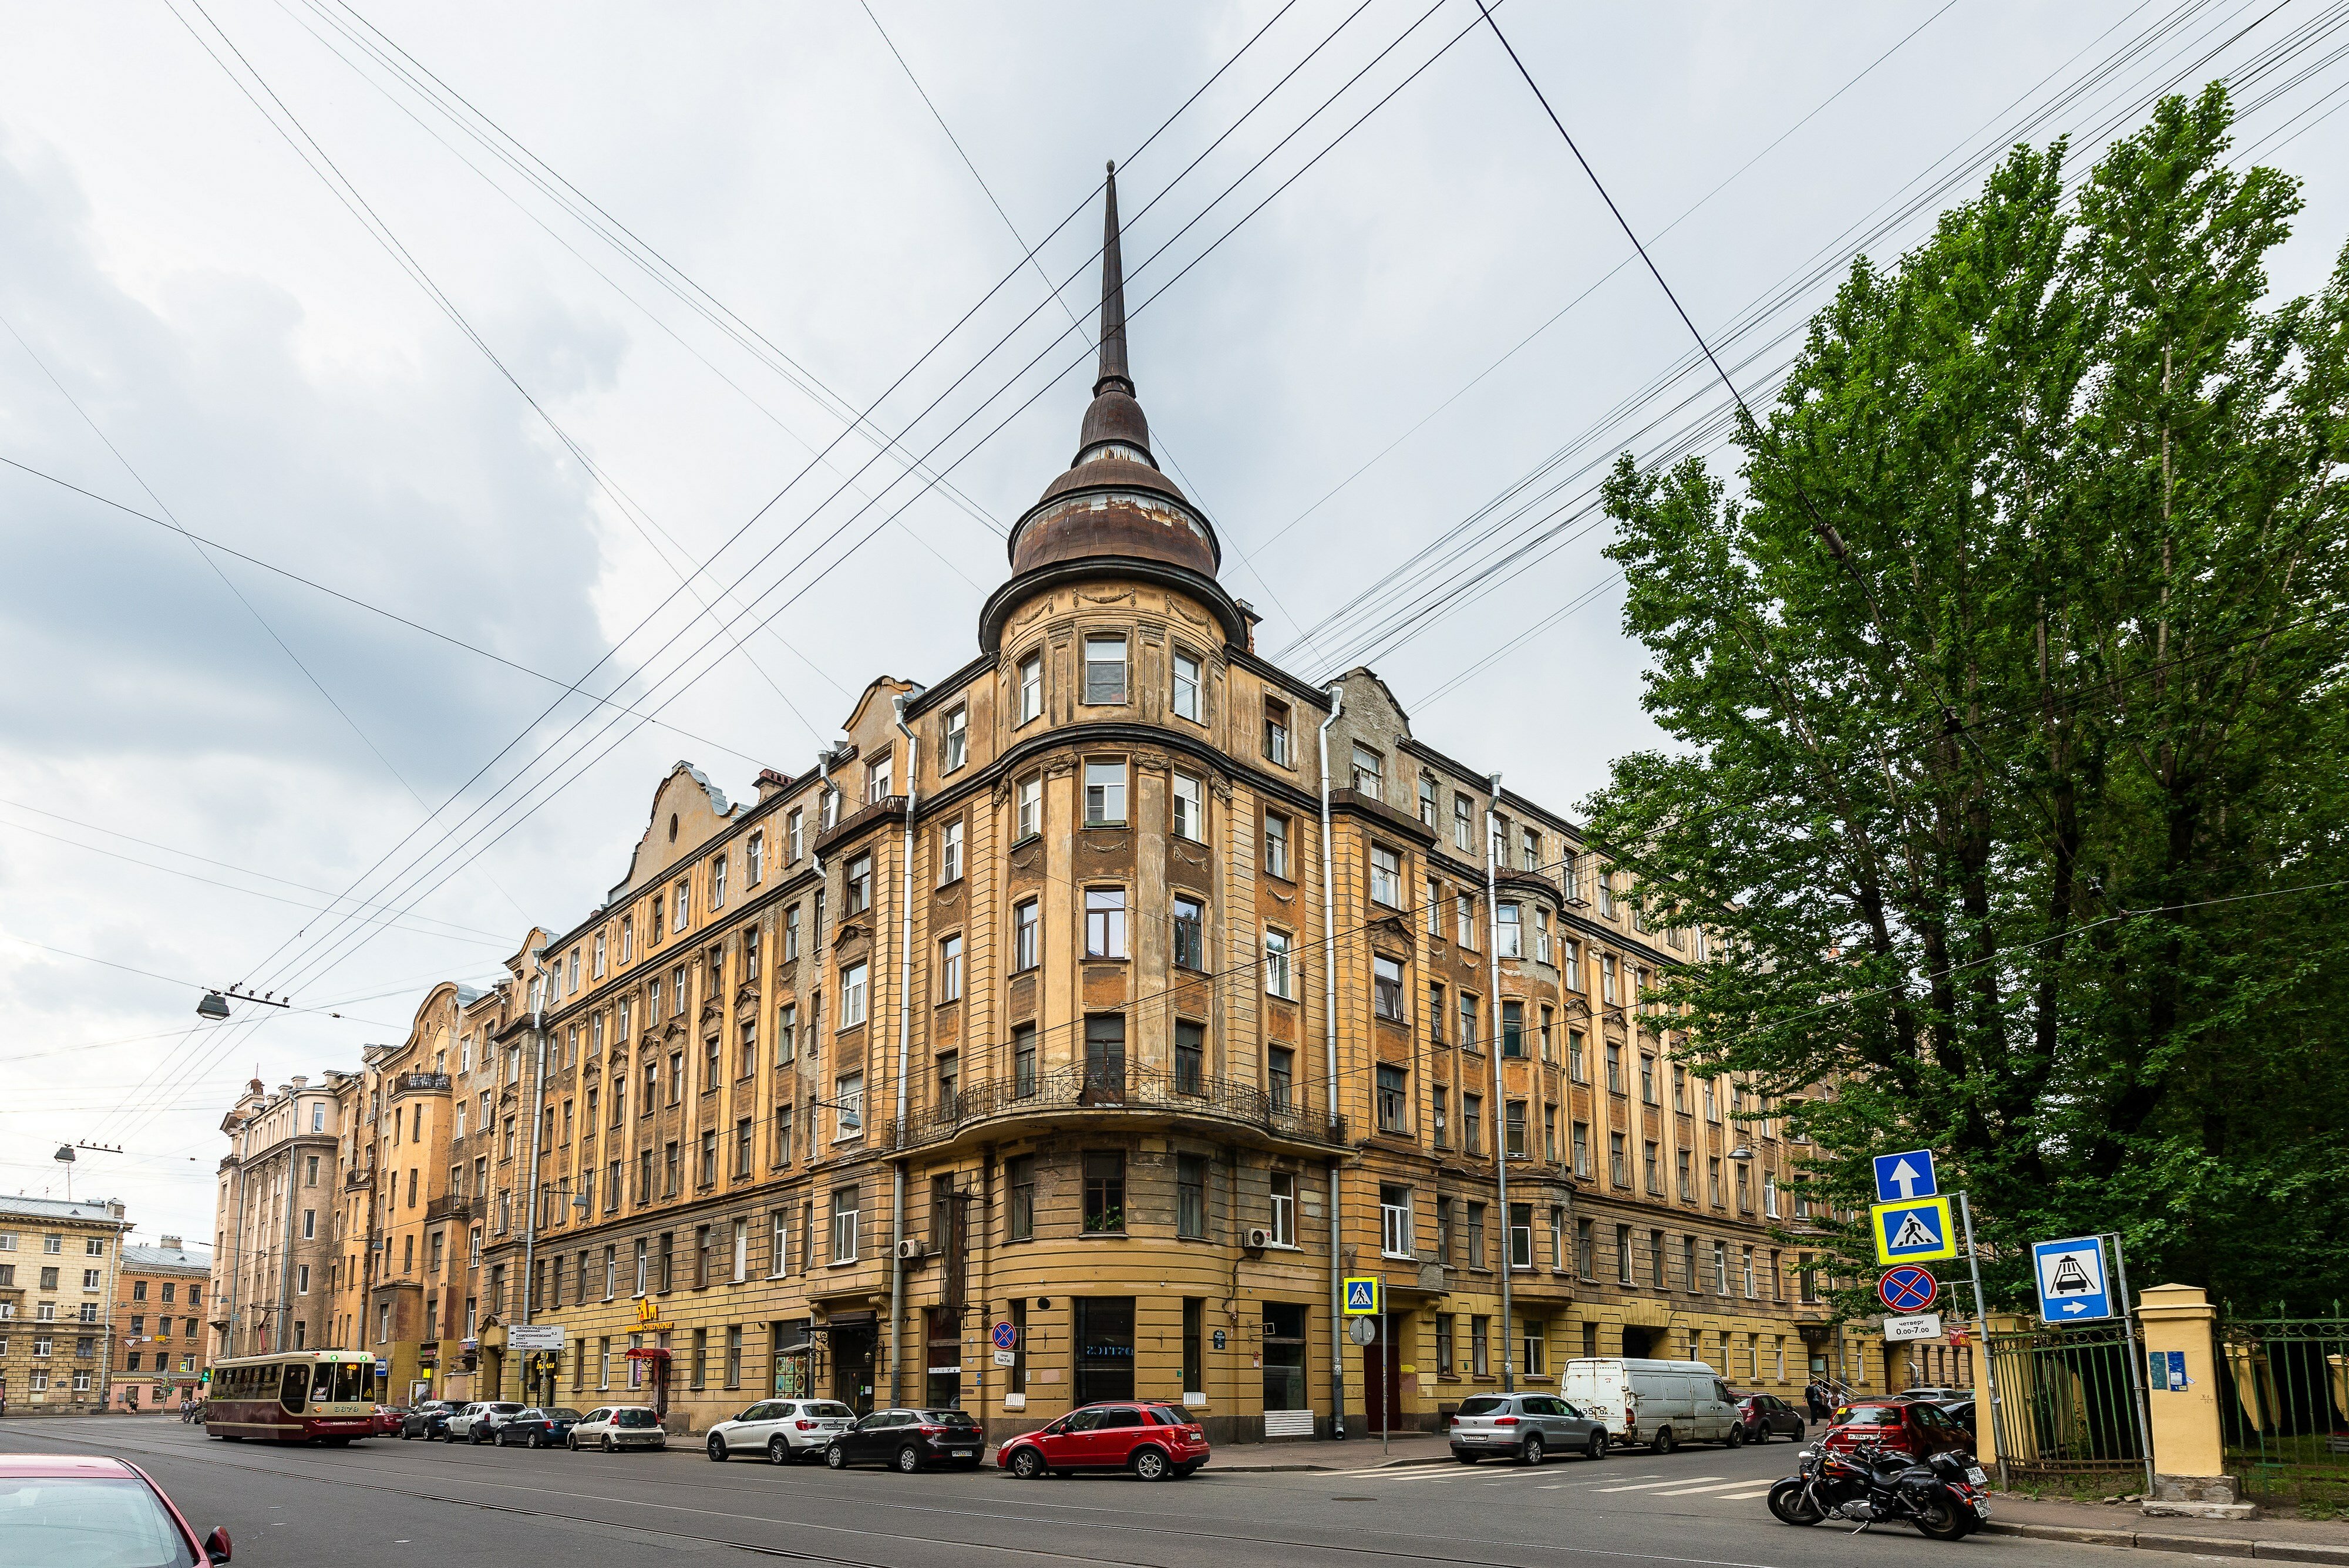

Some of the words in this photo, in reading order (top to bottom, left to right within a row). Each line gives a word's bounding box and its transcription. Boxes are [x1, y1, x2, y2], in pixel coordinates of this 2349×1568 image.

[625, 1324, 643, 1332] ВИННЫЙ
[643, 1322, 673, 1331] СУПЕРМАРКЕТ
[1896, 1327, 1929, 1335] 0.00-7.00
